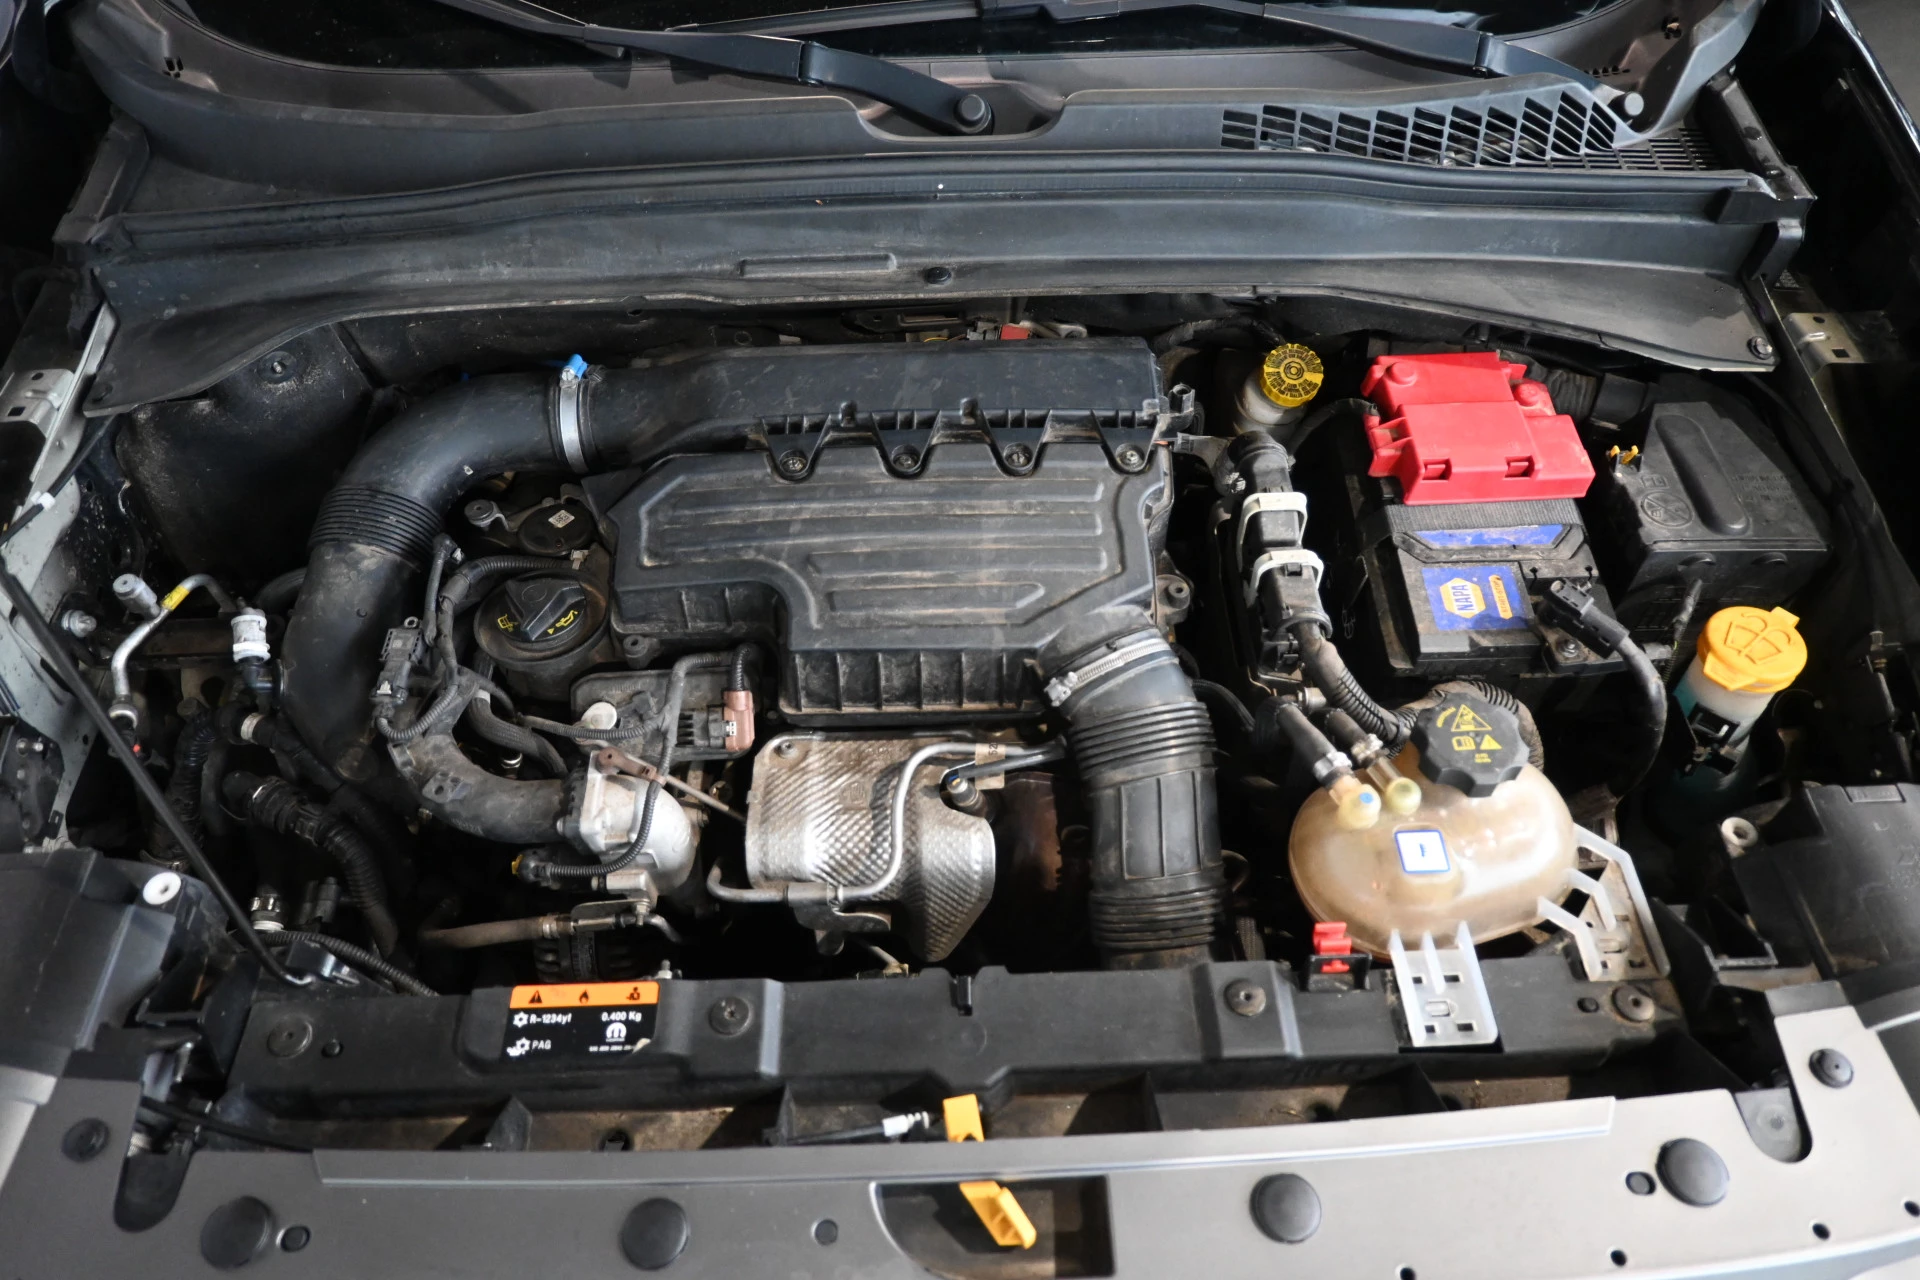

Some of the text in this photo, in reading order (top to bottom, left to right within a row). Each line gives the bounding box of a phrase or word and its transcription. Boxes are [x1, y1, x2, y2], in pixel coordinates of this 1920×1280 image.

[1451, 584, 1475, 611] NAPA
[529, 1013, 572, 1024] R-1234yf
[601, 1011, 642, 1023] 0.400 Kg
[532, 1039, 551, 1050] PAG
